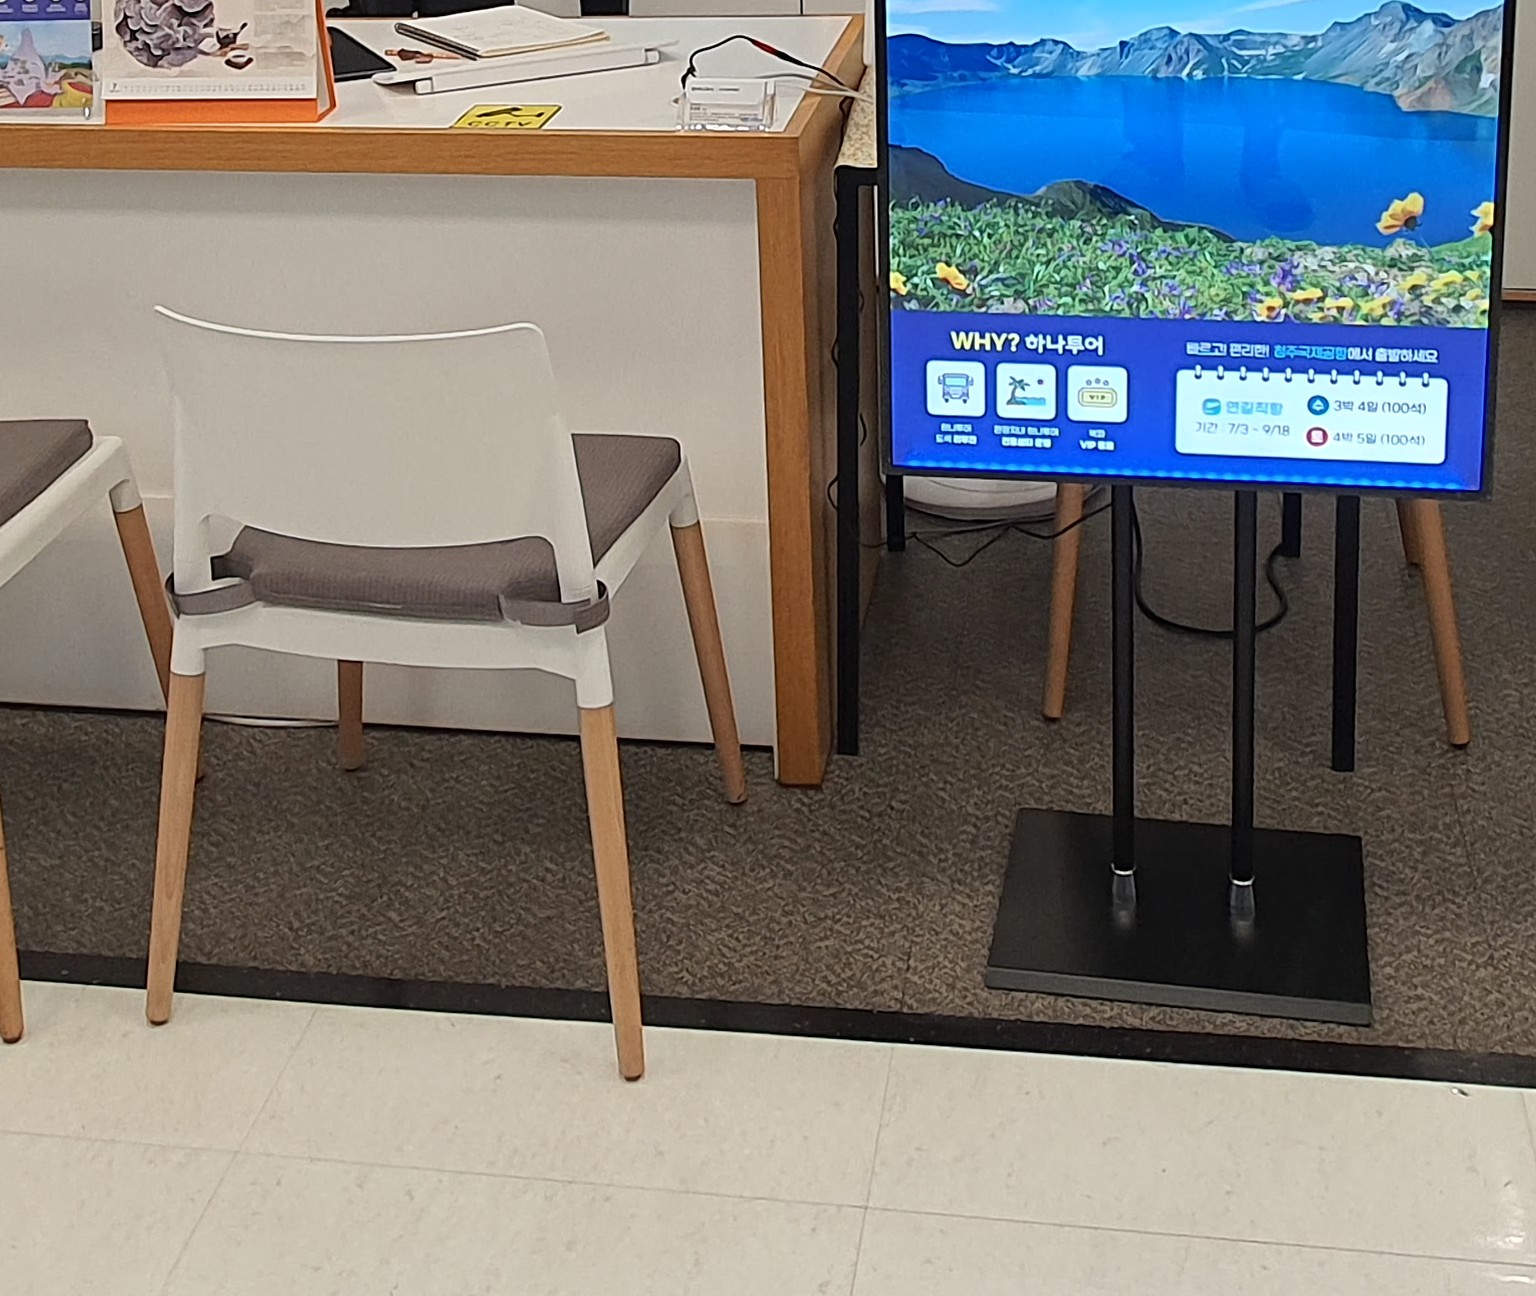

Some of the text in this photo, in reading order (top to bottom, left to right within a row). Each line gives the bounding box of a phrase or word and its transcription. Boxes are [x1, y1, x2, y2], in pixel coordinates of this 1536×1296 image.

[950, 331, 1104, 356] WHY? 하나투어
[1374, 348, 1438, 363] 출발하세요
[1334, 400, 1427, 414] 3박 4일 (100석)
[1195, 422, 1290, 436] 기간 7/3 9/18
[1333, 432, 1425, 446] 4박 5일 (100석)
